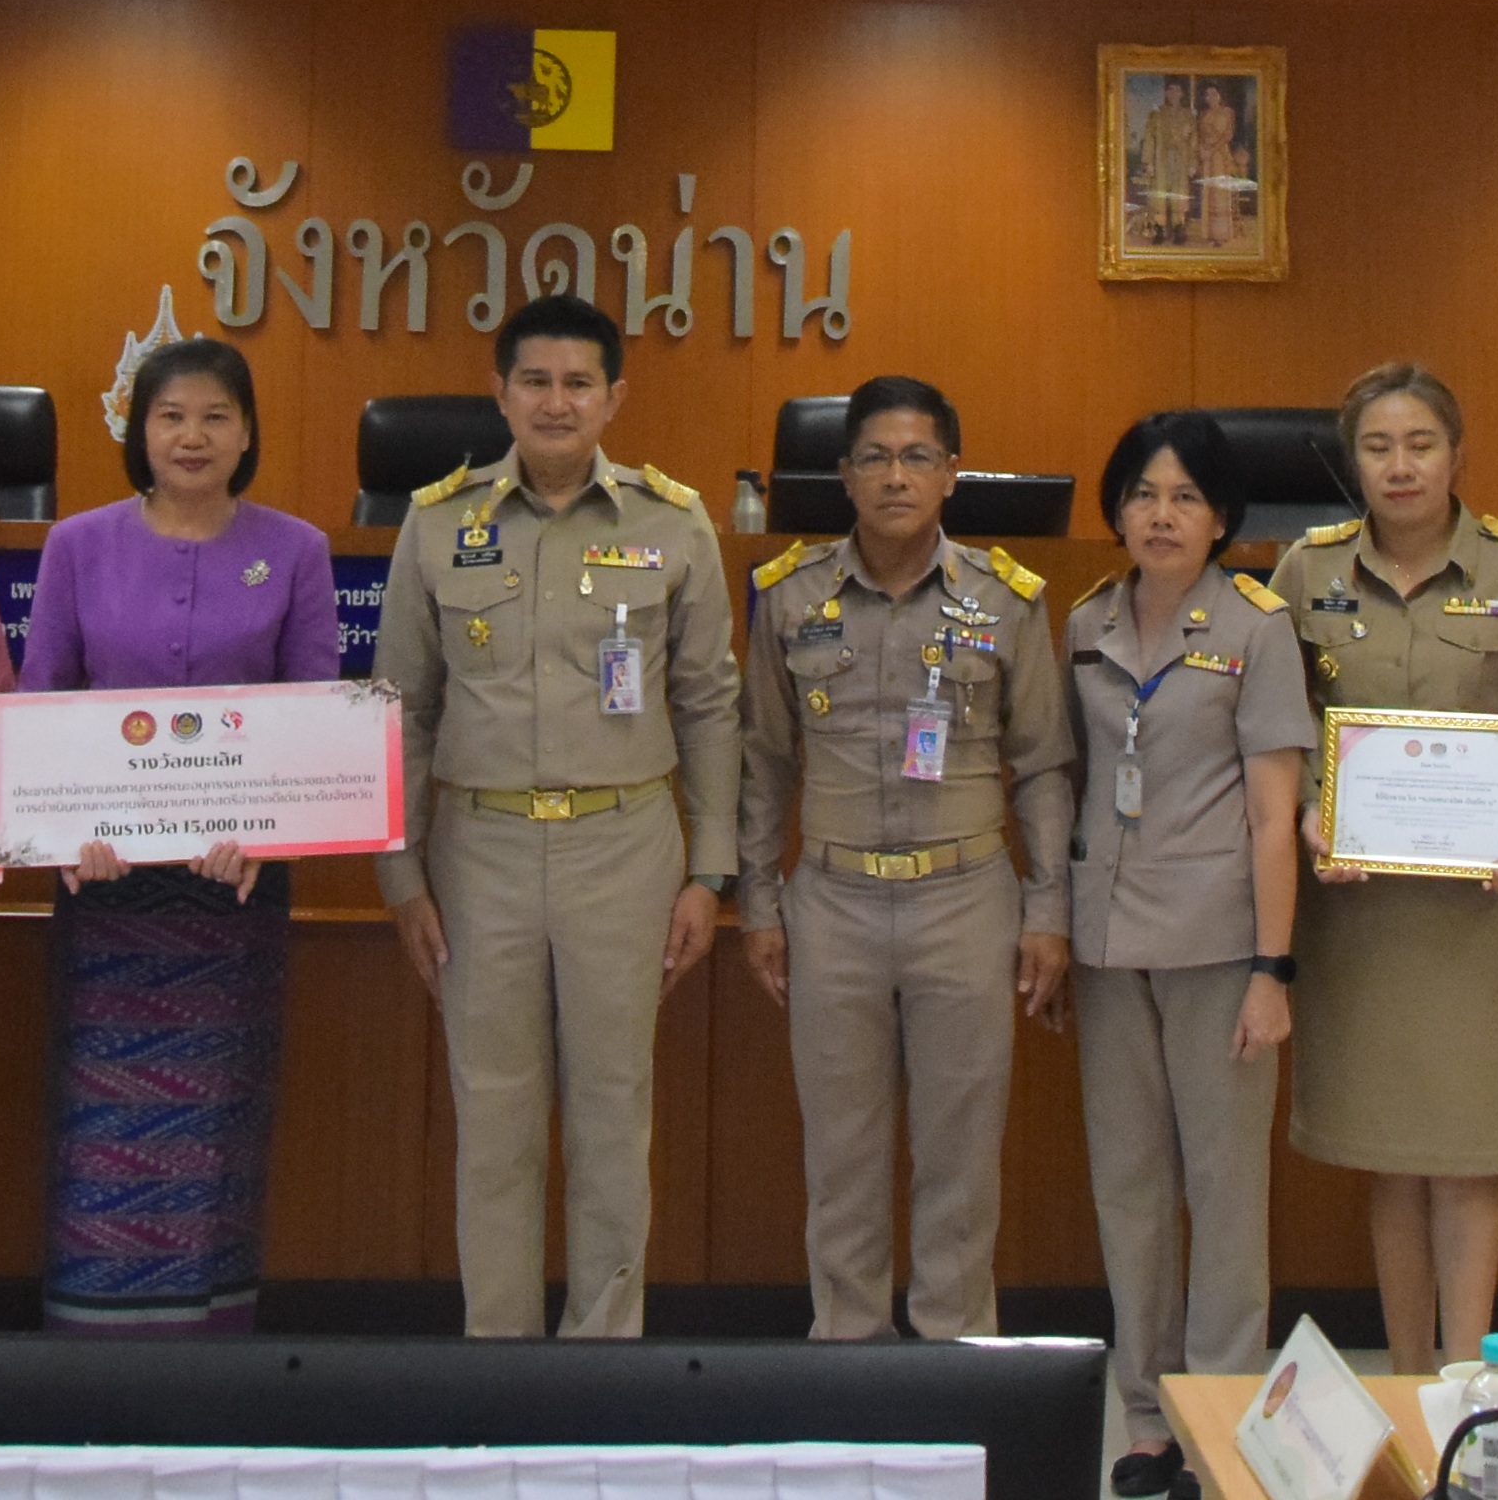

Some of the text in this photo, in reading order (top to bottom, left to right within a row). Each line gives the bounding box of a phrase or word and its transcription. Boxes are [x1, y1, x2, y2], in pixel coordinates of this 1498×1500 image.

[197, 155, 853, 340] จังหวัดน่าน
[127, 752, 243, 770] รางวัลชนะเลิศ
[304, 788, 373, 803] ระดับจังหวัด
[94, 817, 276, 837] เงินรางวัล 15,000 บาท
